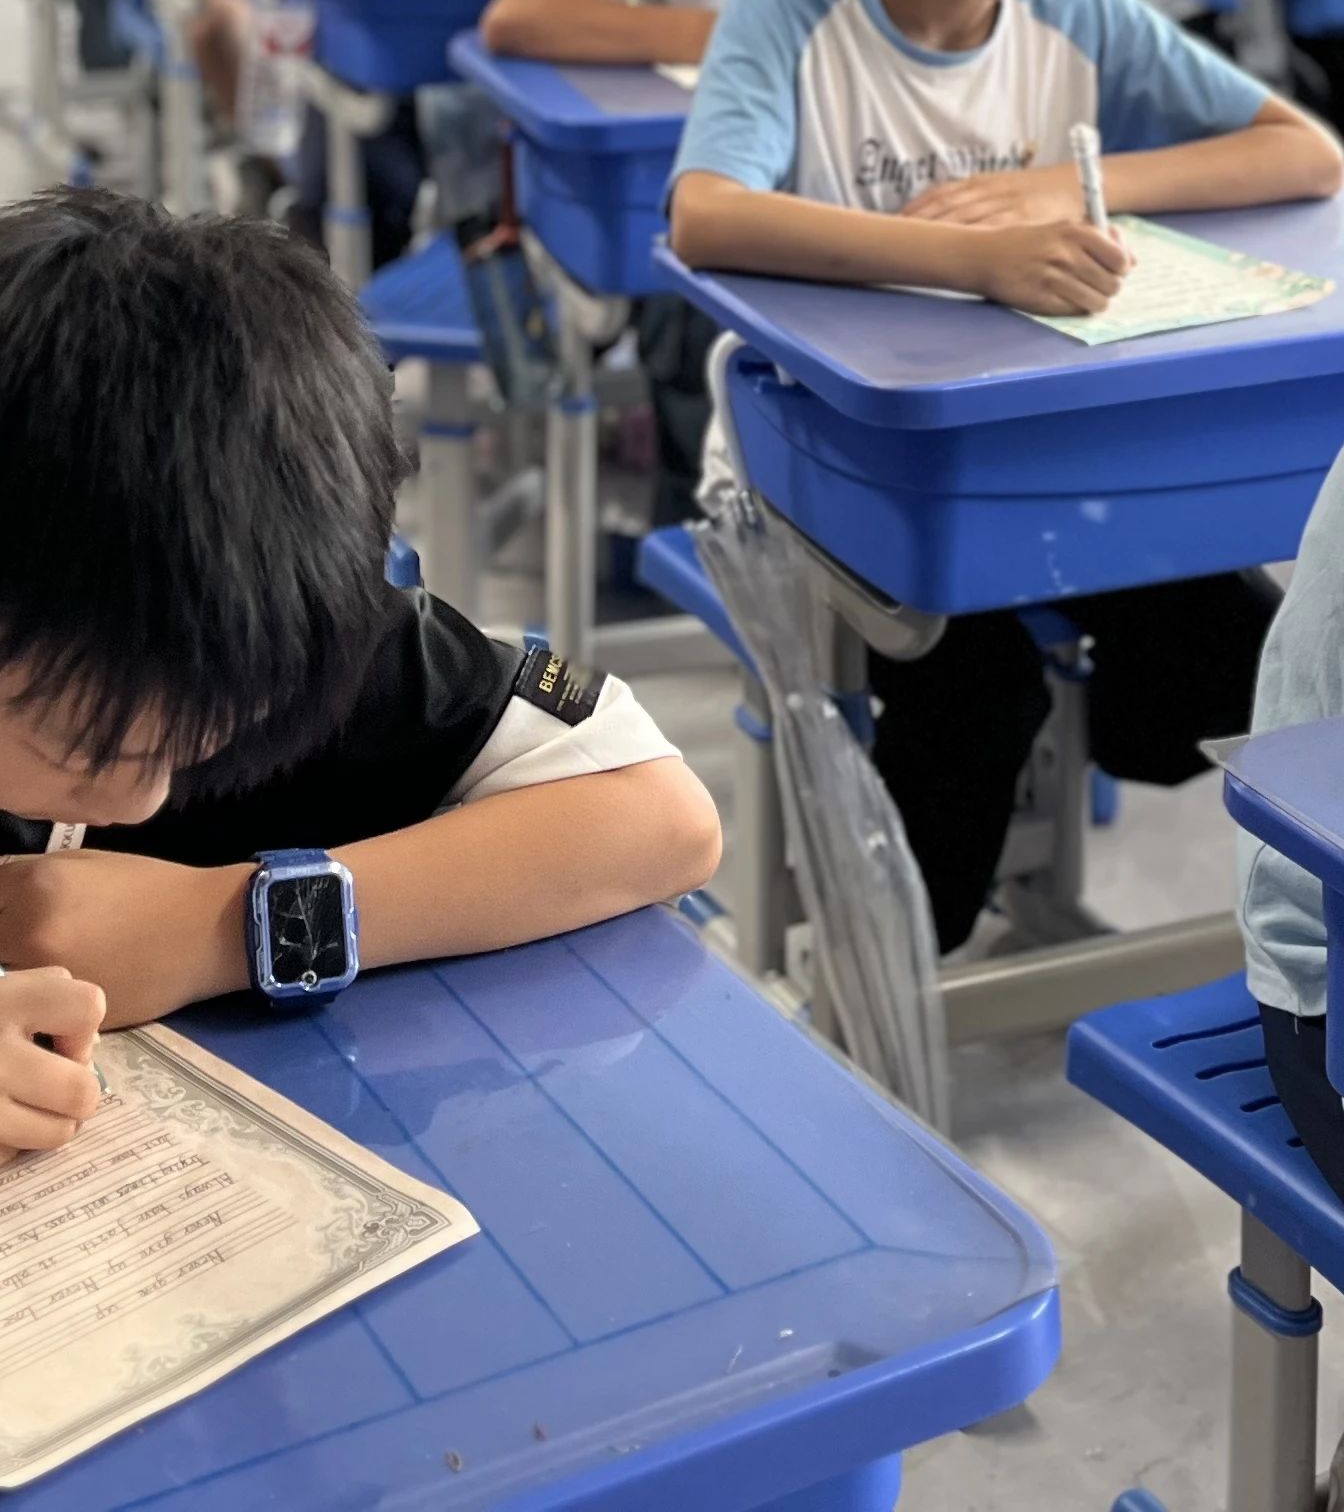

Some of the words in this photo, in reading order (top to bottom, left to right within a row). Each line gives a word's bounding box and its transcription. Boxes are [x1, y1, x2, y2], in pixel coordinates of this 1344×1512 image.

[131, 1203, 172, 1225] have
[182, 1209, 223, 1236] Never
[138, 1231, 174, 1260] give
[177, 1248, 224, 1278] Never
[47, 1274, 100, 1307] Never
[95, 1303, 119, 1321] up
